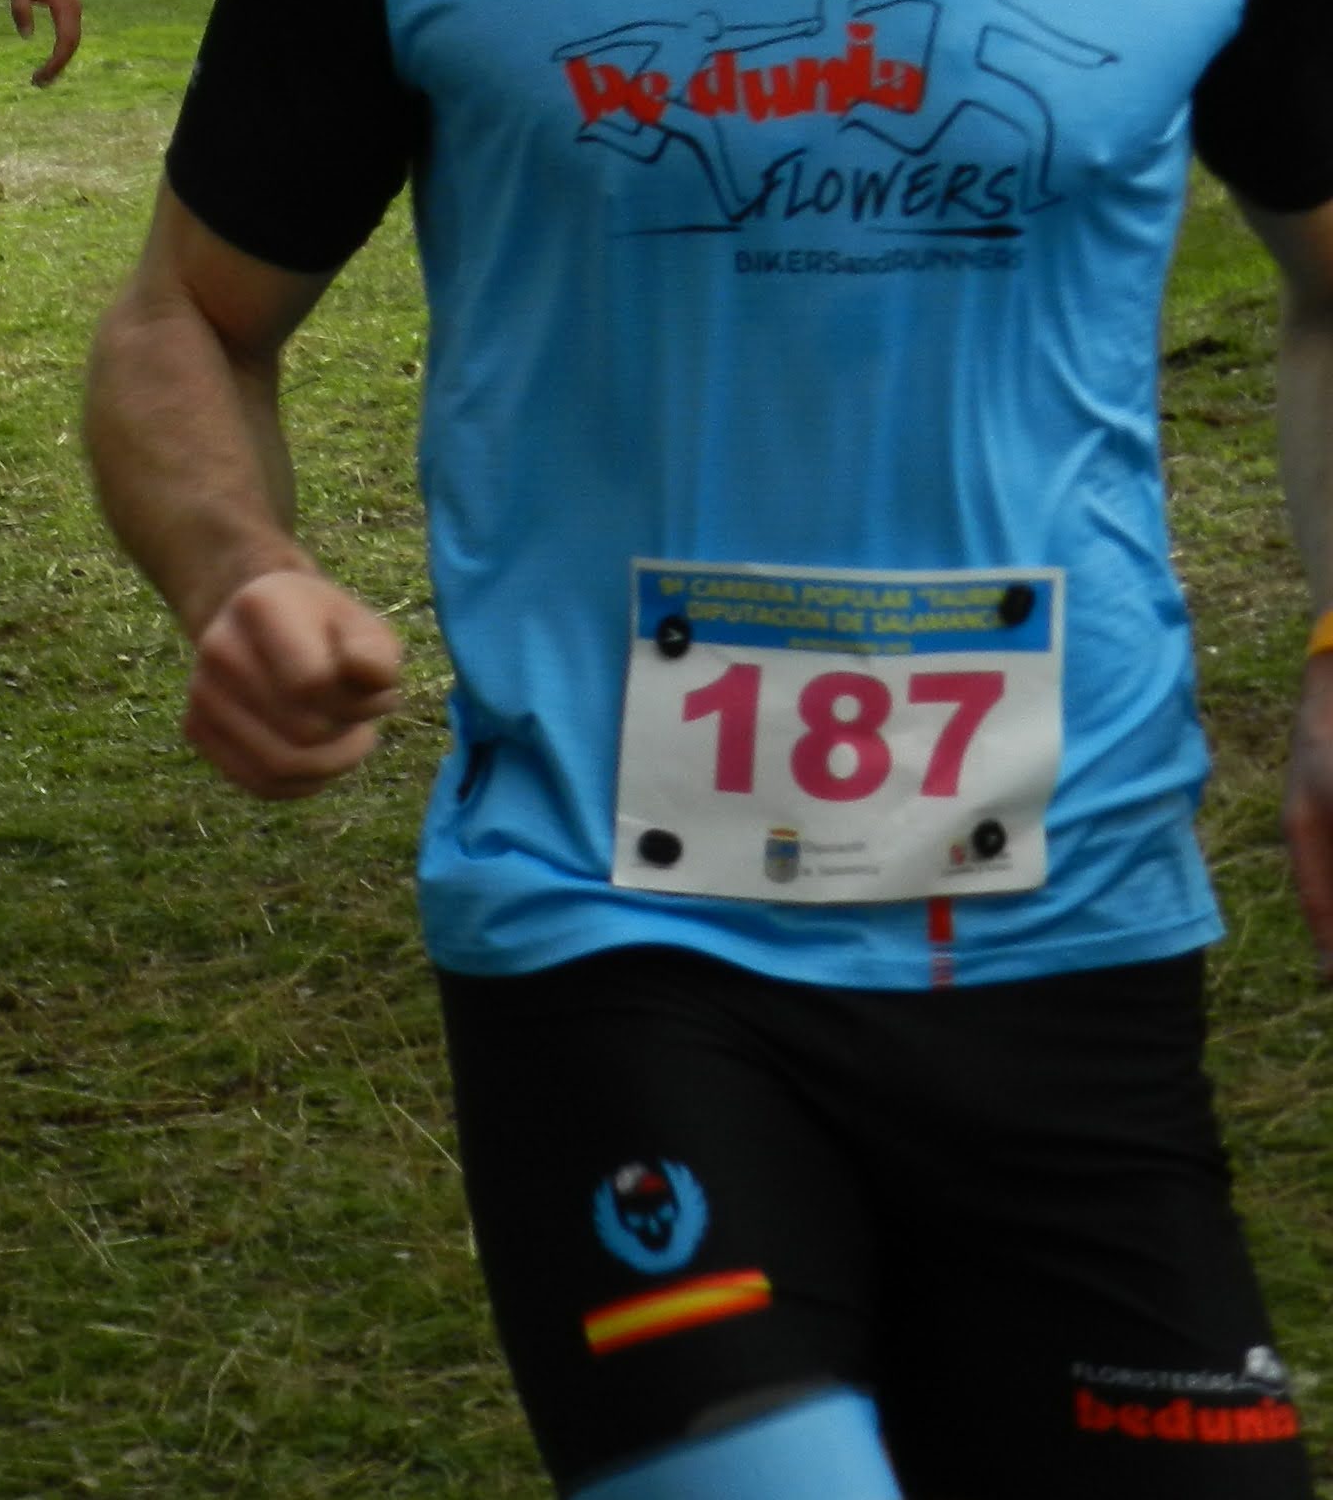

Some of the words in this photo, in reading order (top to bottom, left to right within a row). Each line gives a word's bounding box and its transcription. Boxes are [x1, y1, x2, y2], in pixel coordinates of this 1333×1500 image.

[753, 148, 1023, 221] FLOWERS
[690, 579, 794, 602] CARRERA
[801, 586, 911, 609] POPULAR
[835, 611, 864, 632] DE
[873, 612, 1001, 633] SALAMANC
[682, 663, 1005, 803] 187
